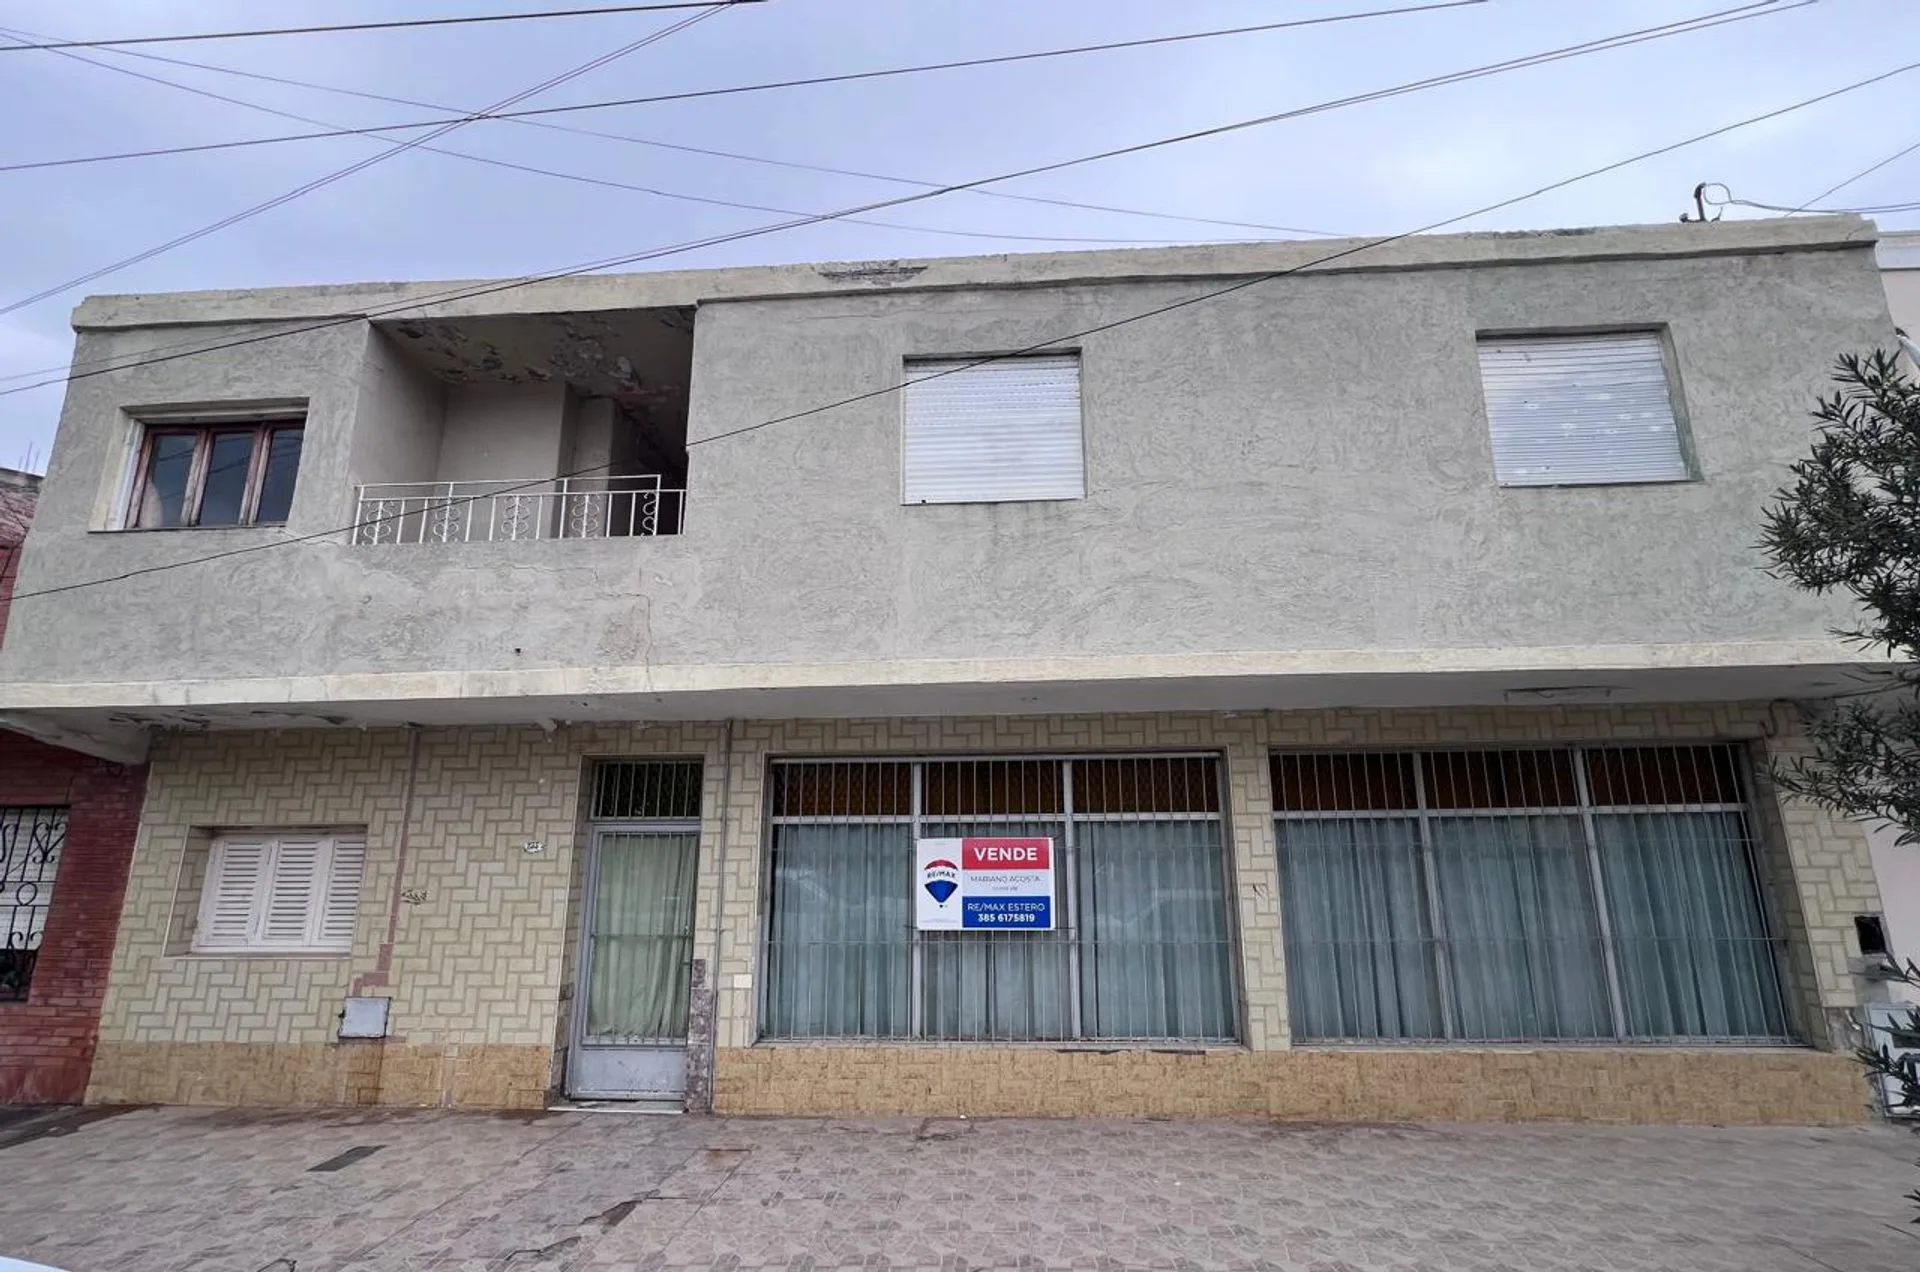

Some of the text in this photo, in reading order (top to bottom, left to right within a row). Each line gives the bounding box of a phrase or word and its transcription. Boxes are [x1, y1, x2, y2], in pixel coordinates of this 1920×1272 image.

[974, 847, 1038, 861] VENDE
[927, 871, 956, 879] RE/MAX
[970, 875, 1041, 883] MARIANO ACOSTA
[967, 903, 1045, 912] RE/MAX ESTERO
[978, 913, 1035, 922] 385 6175819
